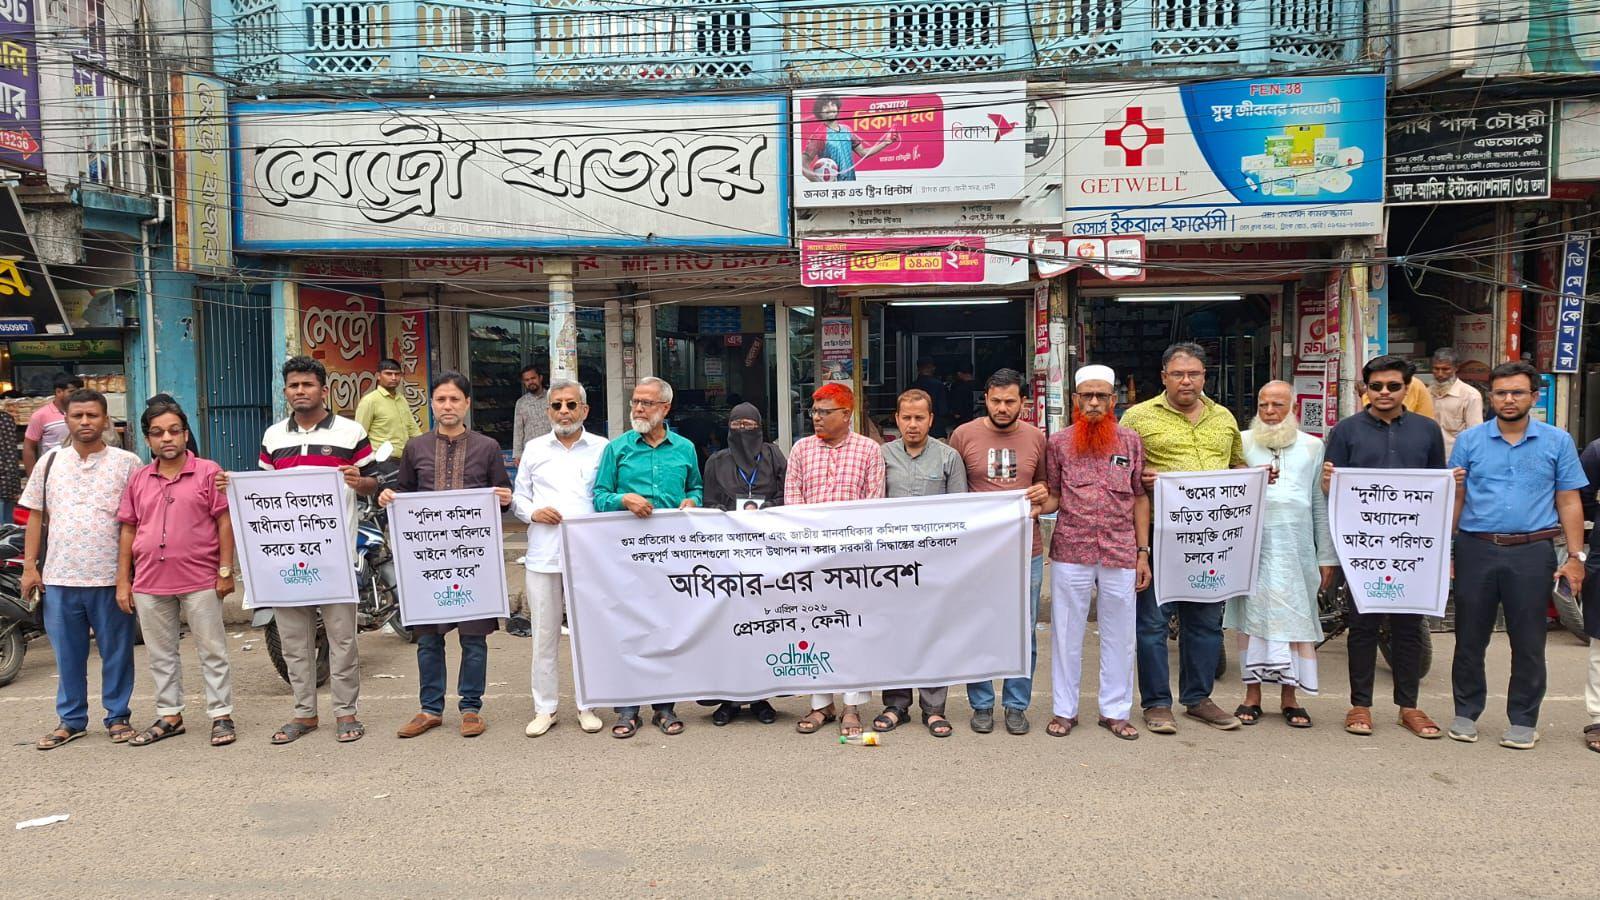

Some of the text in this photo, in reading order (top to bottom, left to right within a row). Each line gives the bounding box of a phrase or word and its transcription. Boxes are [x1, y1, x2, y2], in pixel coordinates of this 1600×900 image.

[1250, 82, 1302, 97] FEN-38
[1440, 116, 1479, 132] পাল
[1486, 109, 1547, 131] চৌধুরী
[950, 120, 990, 141] বিকাশ
[1474, 133, 1544, 148] এডভোকেট
[254, 109, 769, 224] মেট্রো বাজার
[803, 189, 829, 199] জনতা
[1080, 176, 1189, 195] GETWELL
[1110, 211, 1167, 236] ইকবাল
[1168, 208, 1227, 233] ফার্মেসী
[621, 253, 714, 273] METRO
[303, 296, 376, 360] মেট্রো
[245, 491, 334, 510] “বিচার বিভাগের
[1178, 483, 1248, 500] “গুমের সাথে
[1402, 489, 1436, 504] দমন
[248, 513, 337, 535] স্বাধীনতা নিশ্চিত
[408, 505, 483, 525] “পুলিশ কমিশন
[1169, 504, 1253, 526] জড়িত ব্যক্তিদের
[1359, 511, 1421, 527] অধ্যাদেশ
[402, 525, 492, 543] অধ্যাদেশ অবিলম্বে
[620, 520, 968, 548] গুম প্রতিরোধ ও প্রতিকার অধ্যাদেশ এবং জাতীয় মানবাধিকার কমিশন অধ্যাদেশসহ
[1176, 526, 1244, 547] দায়মুক্তি দেয়া
[1342, 530, 1436, 549] আইনে পরিণত
[260, 543, 296, 557] করতে
[413, 544, 486, 561] আইনে পরিনত
[631, 536, 960, 563] গুরুত্বপূর্ণ অধ্যাদেশগুলো সংসদে উত্থাপন না করার সরকারী সিদ্ধান্তের প্রতিবাদে
[1183, 546, 1234, 564] চলবে না”
[421, 564, 481, 582] করতে হবে”
[1348, 557, 1425, 572] করতে হবে”
[667, 559, 925, 599] অধিকার-এর সমাবেশ
[763, 602, 828, 616] ৮ এপ্রিল ২০২৬
